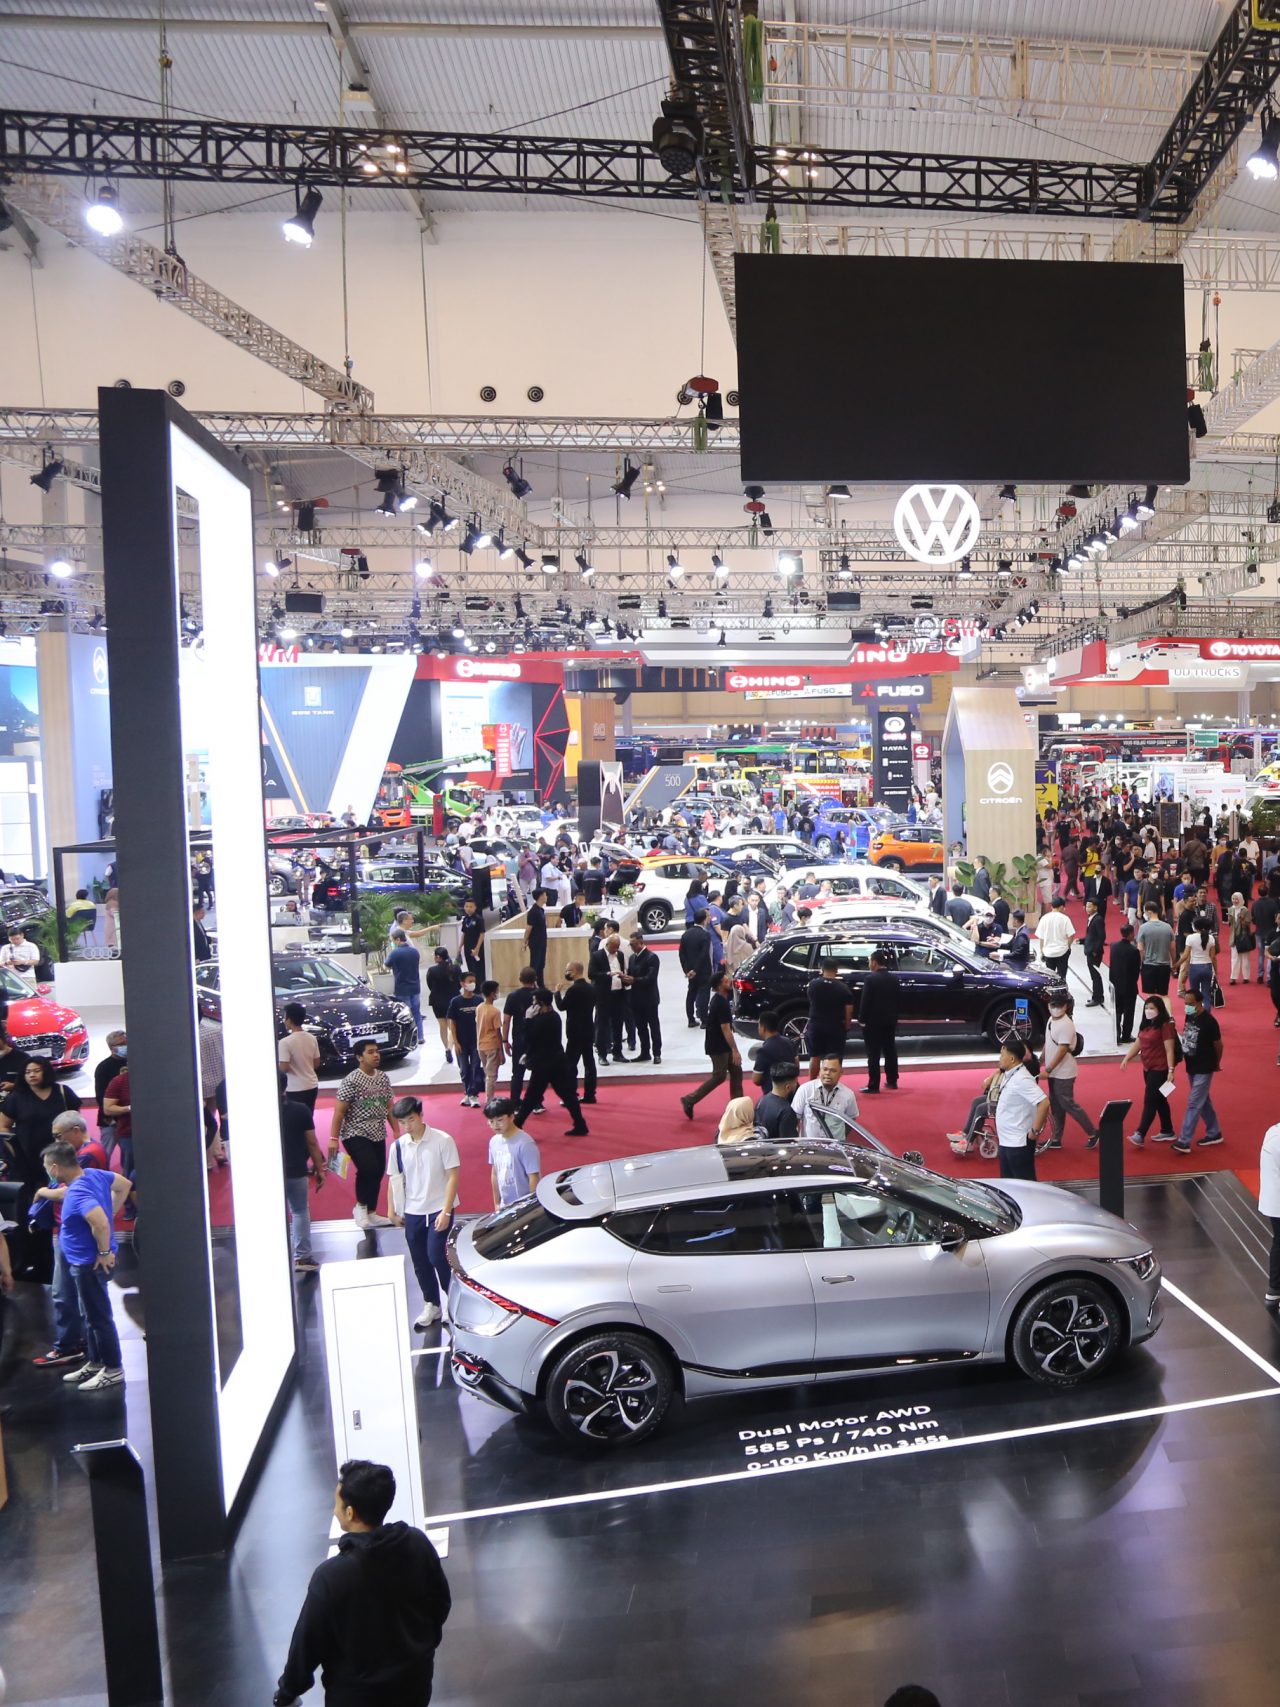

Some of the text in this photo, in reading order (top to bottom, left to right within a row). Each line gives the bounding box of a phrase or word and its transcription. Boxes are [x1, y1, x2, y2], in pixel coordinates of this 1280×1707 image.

[258, 643, 299, 663] WM
[850, 650, 908, 662] INO
[1194, 668, 1240, 677] TRUCKS
[749, 675, 800, 686] HINO
[877, 684, 925, 697] FUSO
[665, 775, 681, 787] 500
[738, 1405, 931, 1441] Dual Motor AWD
[744, 1419, 939, 1456] 585 Ps / 740 Nm
[747, 1454, 808, 1472] 0-100
[813, 1444, 869, 1461] Km/h
[896, 1434, 949, 1449] 3.55s
